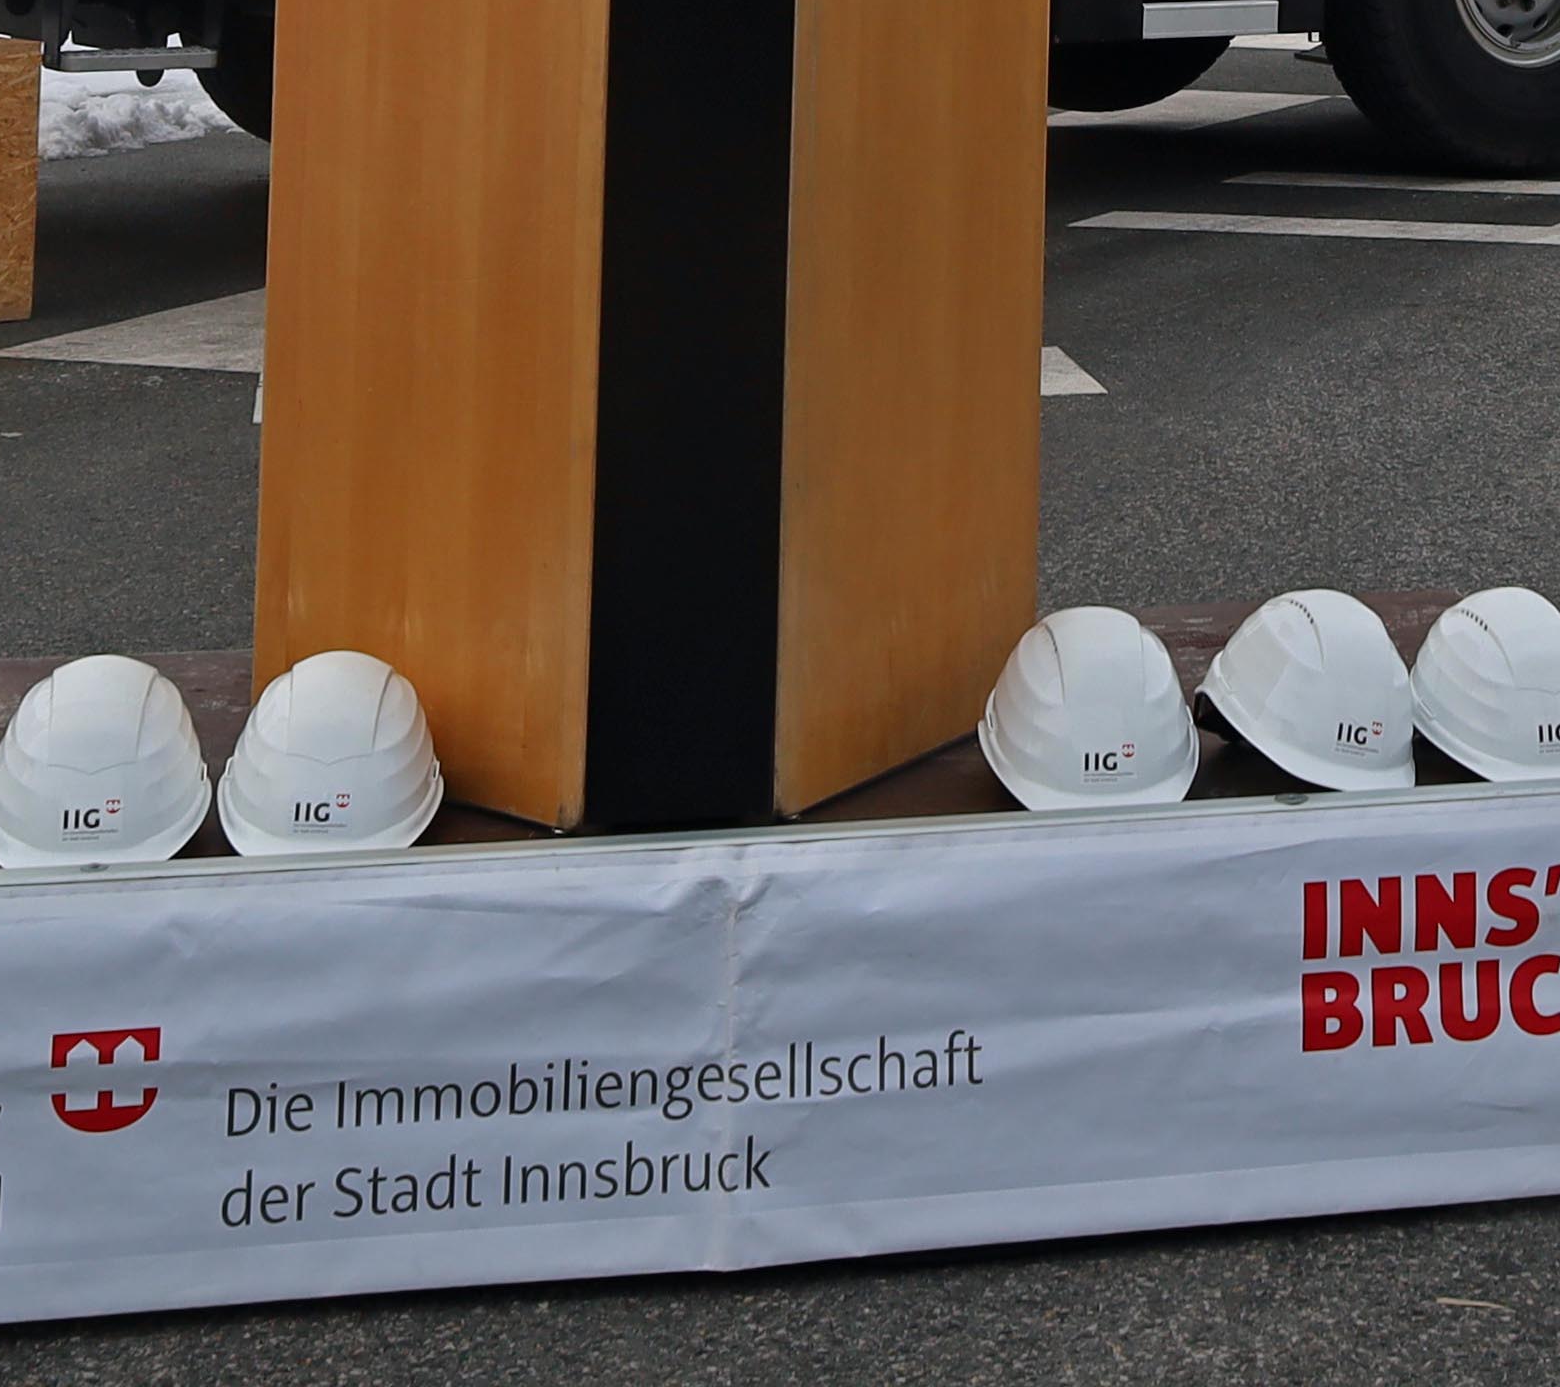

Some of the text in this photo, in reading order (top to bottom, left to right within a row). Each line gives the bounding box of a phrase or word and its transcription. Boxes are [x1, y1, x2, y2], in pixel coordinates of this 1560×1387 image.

[1337, 722, 1369, 746] IIG
[1083, 751, 1119, 772] IIG
[62, 807, 100, 830] IIG
[293, 801, 331, 823] IIG
[225, 1029, 984, 1138] Die Immobiliengesellschaft
[220, 1134, 773, 1229] der Stadt Innsbruck
